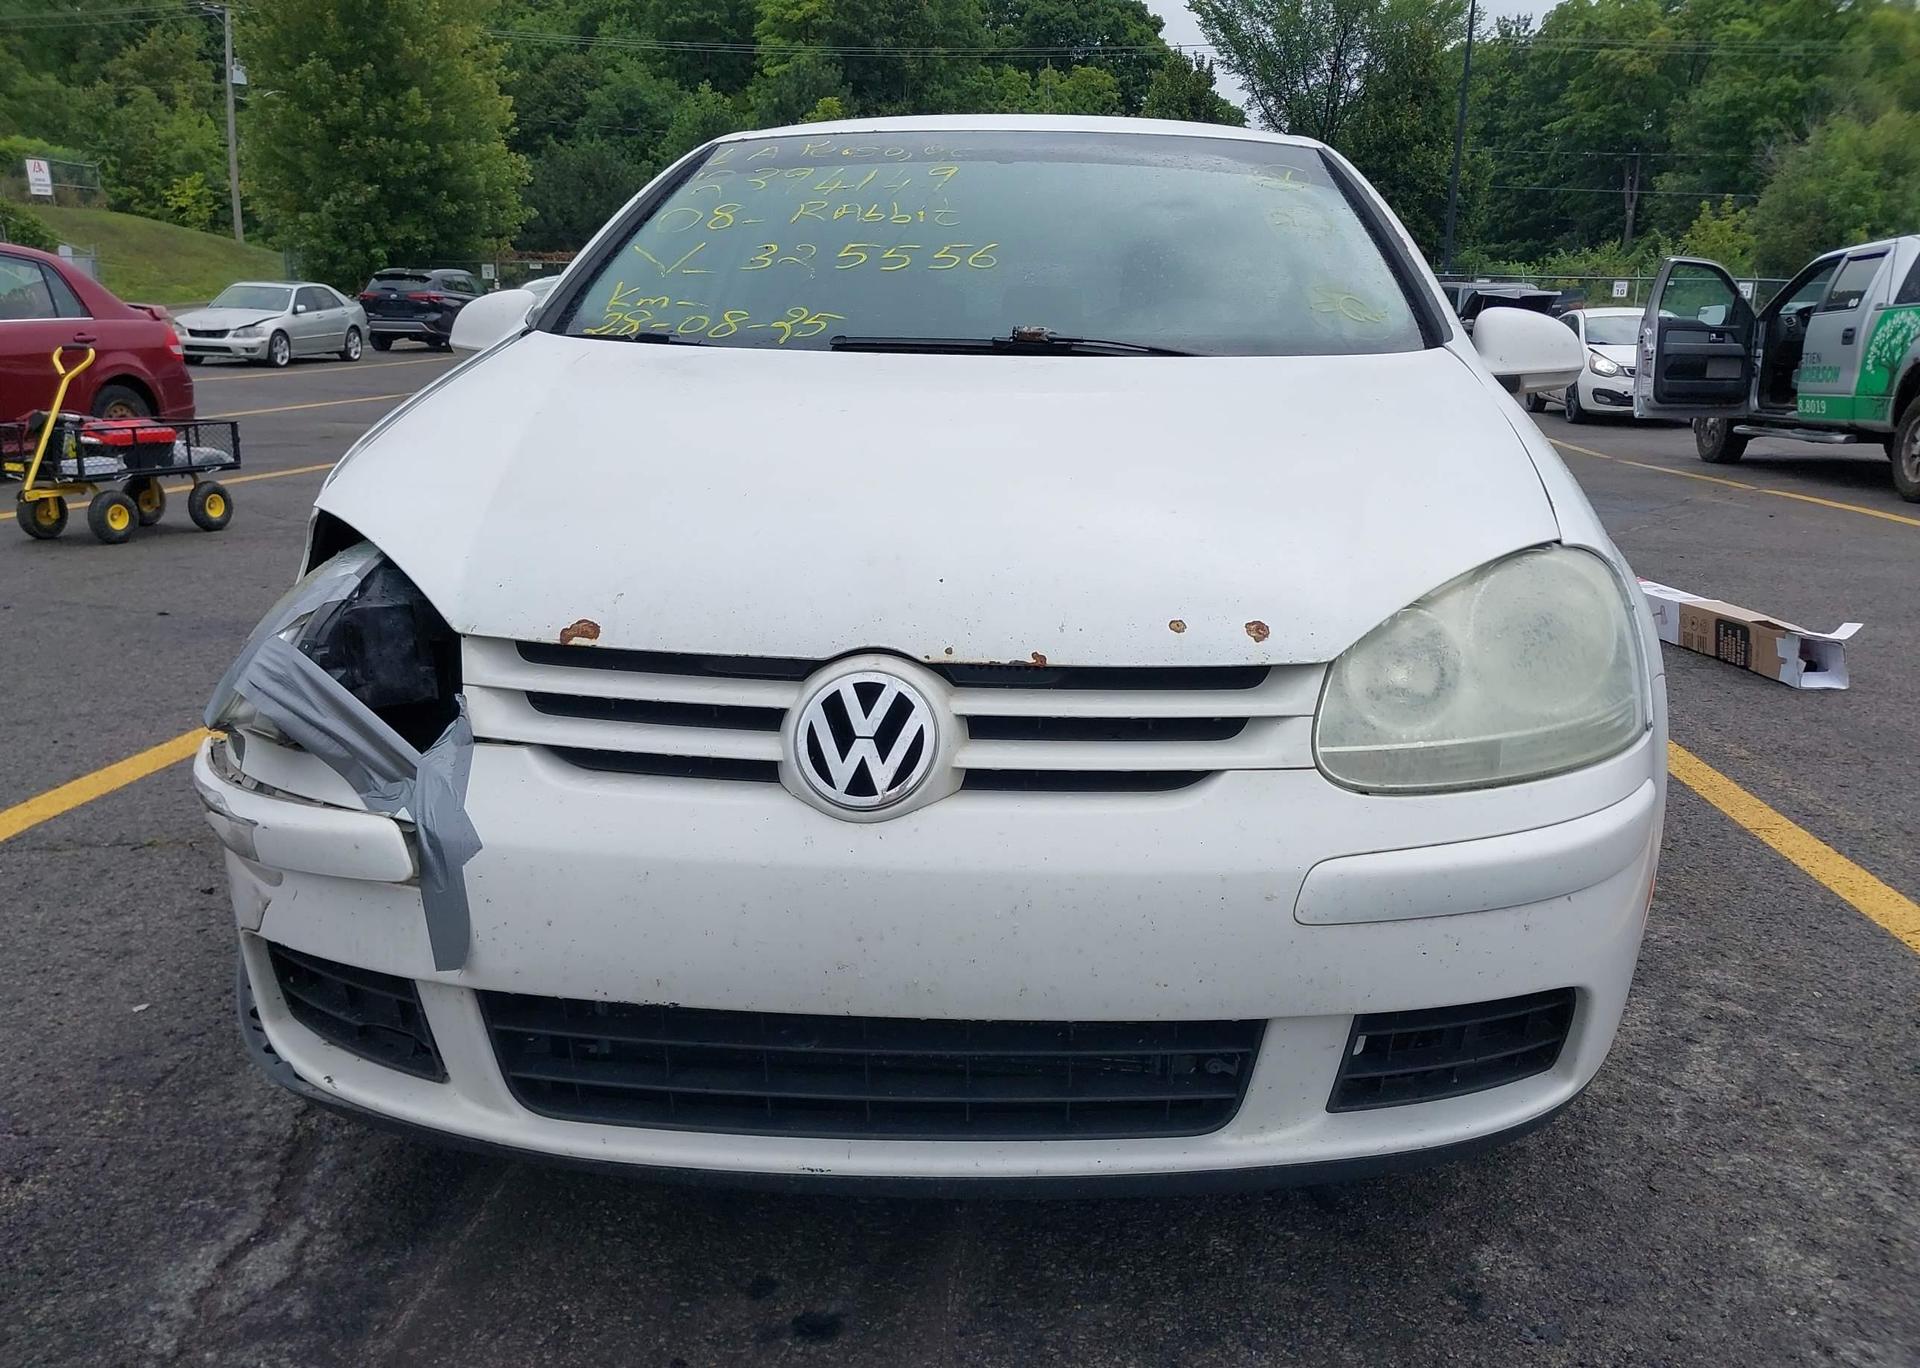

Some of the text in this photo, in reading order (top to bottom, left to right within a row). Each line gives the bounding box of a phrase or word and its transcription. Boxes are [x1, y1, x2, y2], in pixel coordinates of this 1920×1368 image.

[739, 242, 1000, 274] 325556
[1616, 288, 1626, 296] 10
[582, 307, 846, 344] 28-08-25
[802, 676, 930, 802] VW
